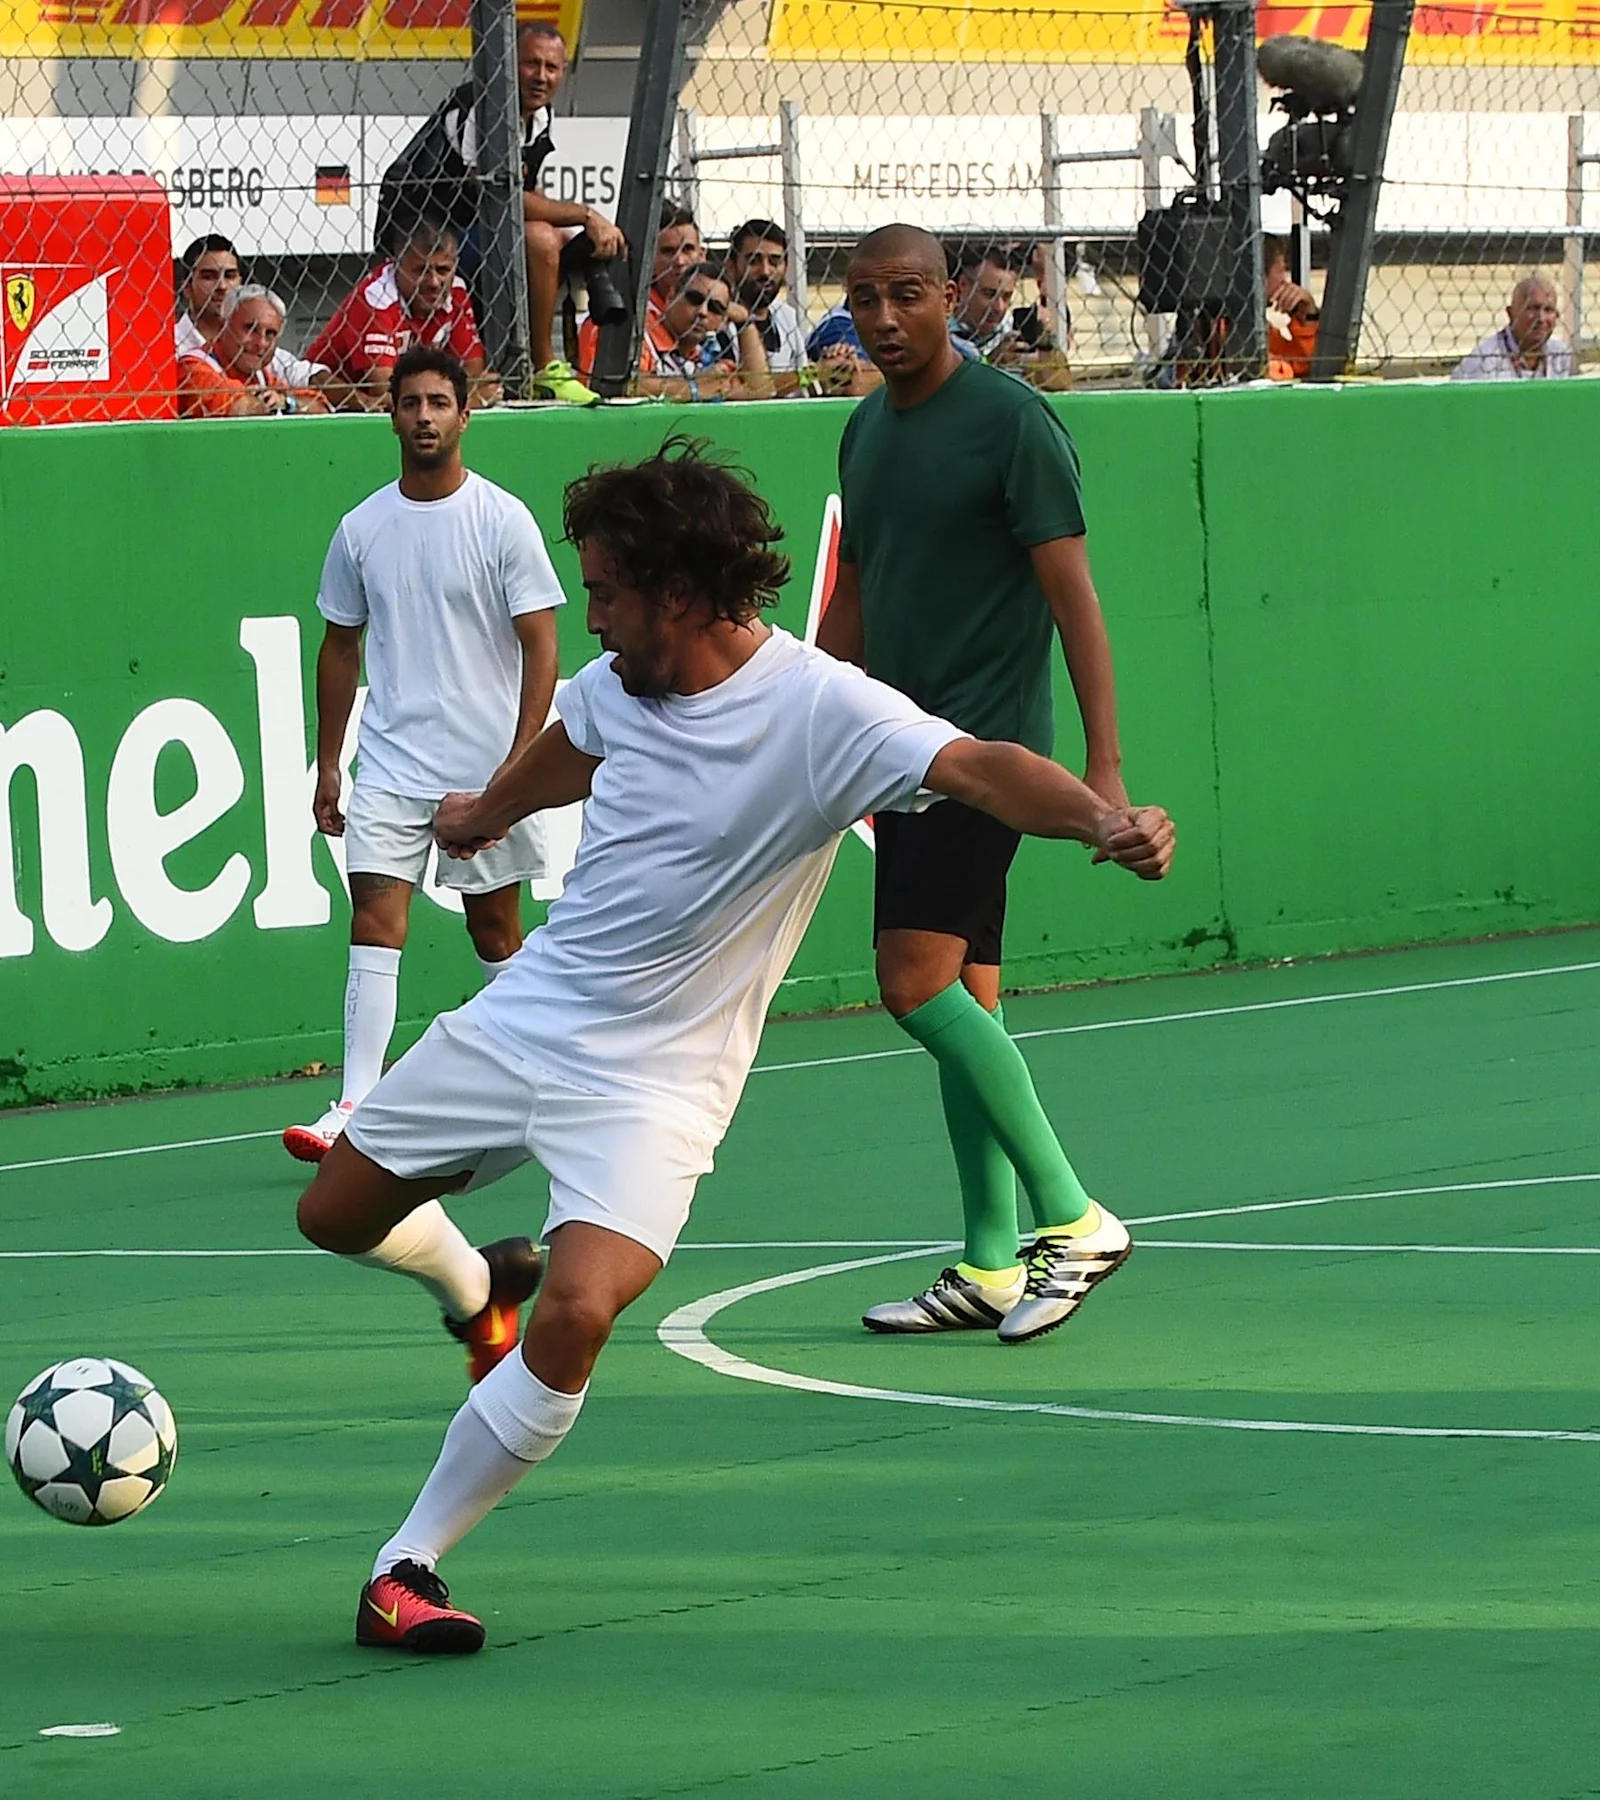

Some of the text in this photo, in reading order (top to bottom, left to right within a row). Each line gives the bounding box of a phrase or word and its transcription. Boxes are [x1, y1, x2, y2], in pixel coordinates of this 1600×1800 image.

[541, 165, 615, 204] EDES
[853, 162, 1043, 200] MERCEDES AM
